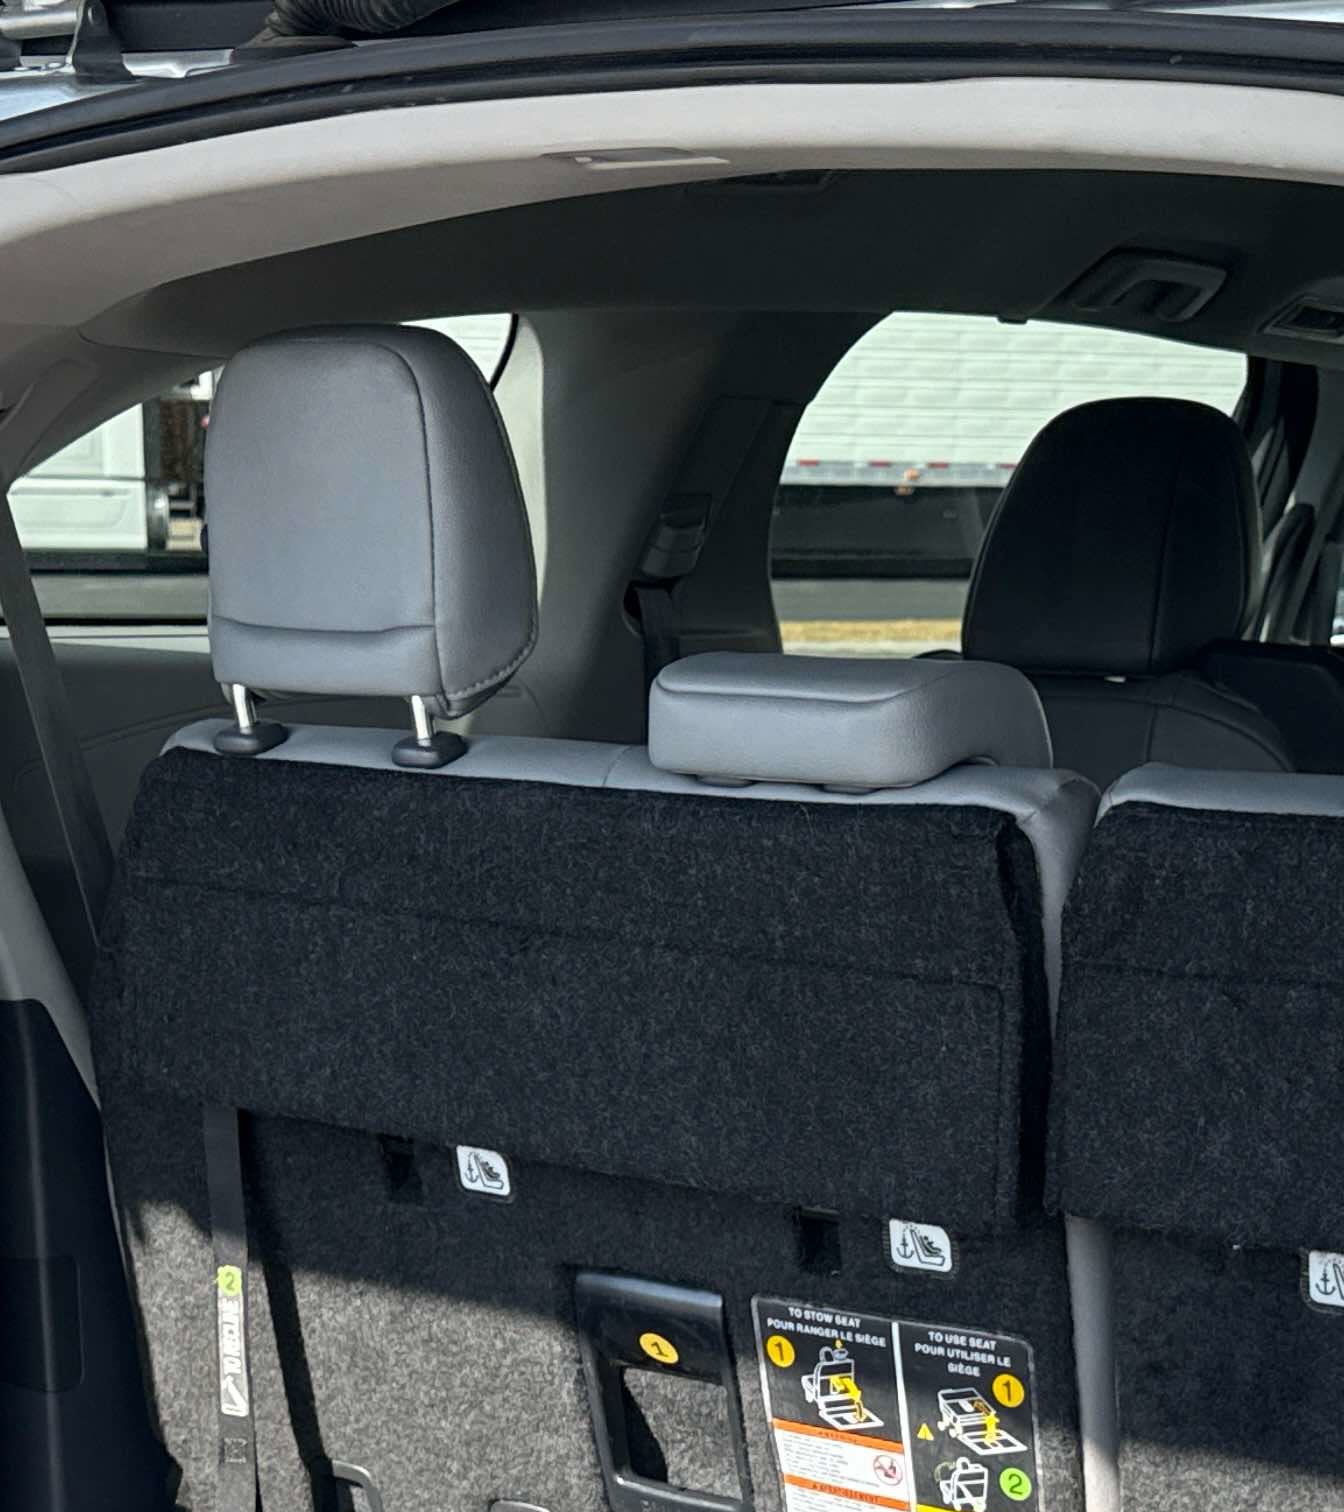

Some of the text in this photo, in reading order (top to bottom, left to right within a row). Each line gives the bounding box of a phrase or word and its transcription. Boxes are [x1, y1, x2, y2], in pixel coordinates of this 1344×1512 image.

[788, 1307, 861, 1328] TO STOW SEAT
[767, 1317, 886, 1347] POUR RANGER LE SIÈGE
[928, 1331, 997, 1351] TO USE SEAT
[914, 1342, 1011, 1368] POUR UTILISER LE
[947, 1361, 981, 1377] SIÈGE
[1008, 1473, 1023, 1495] 2
